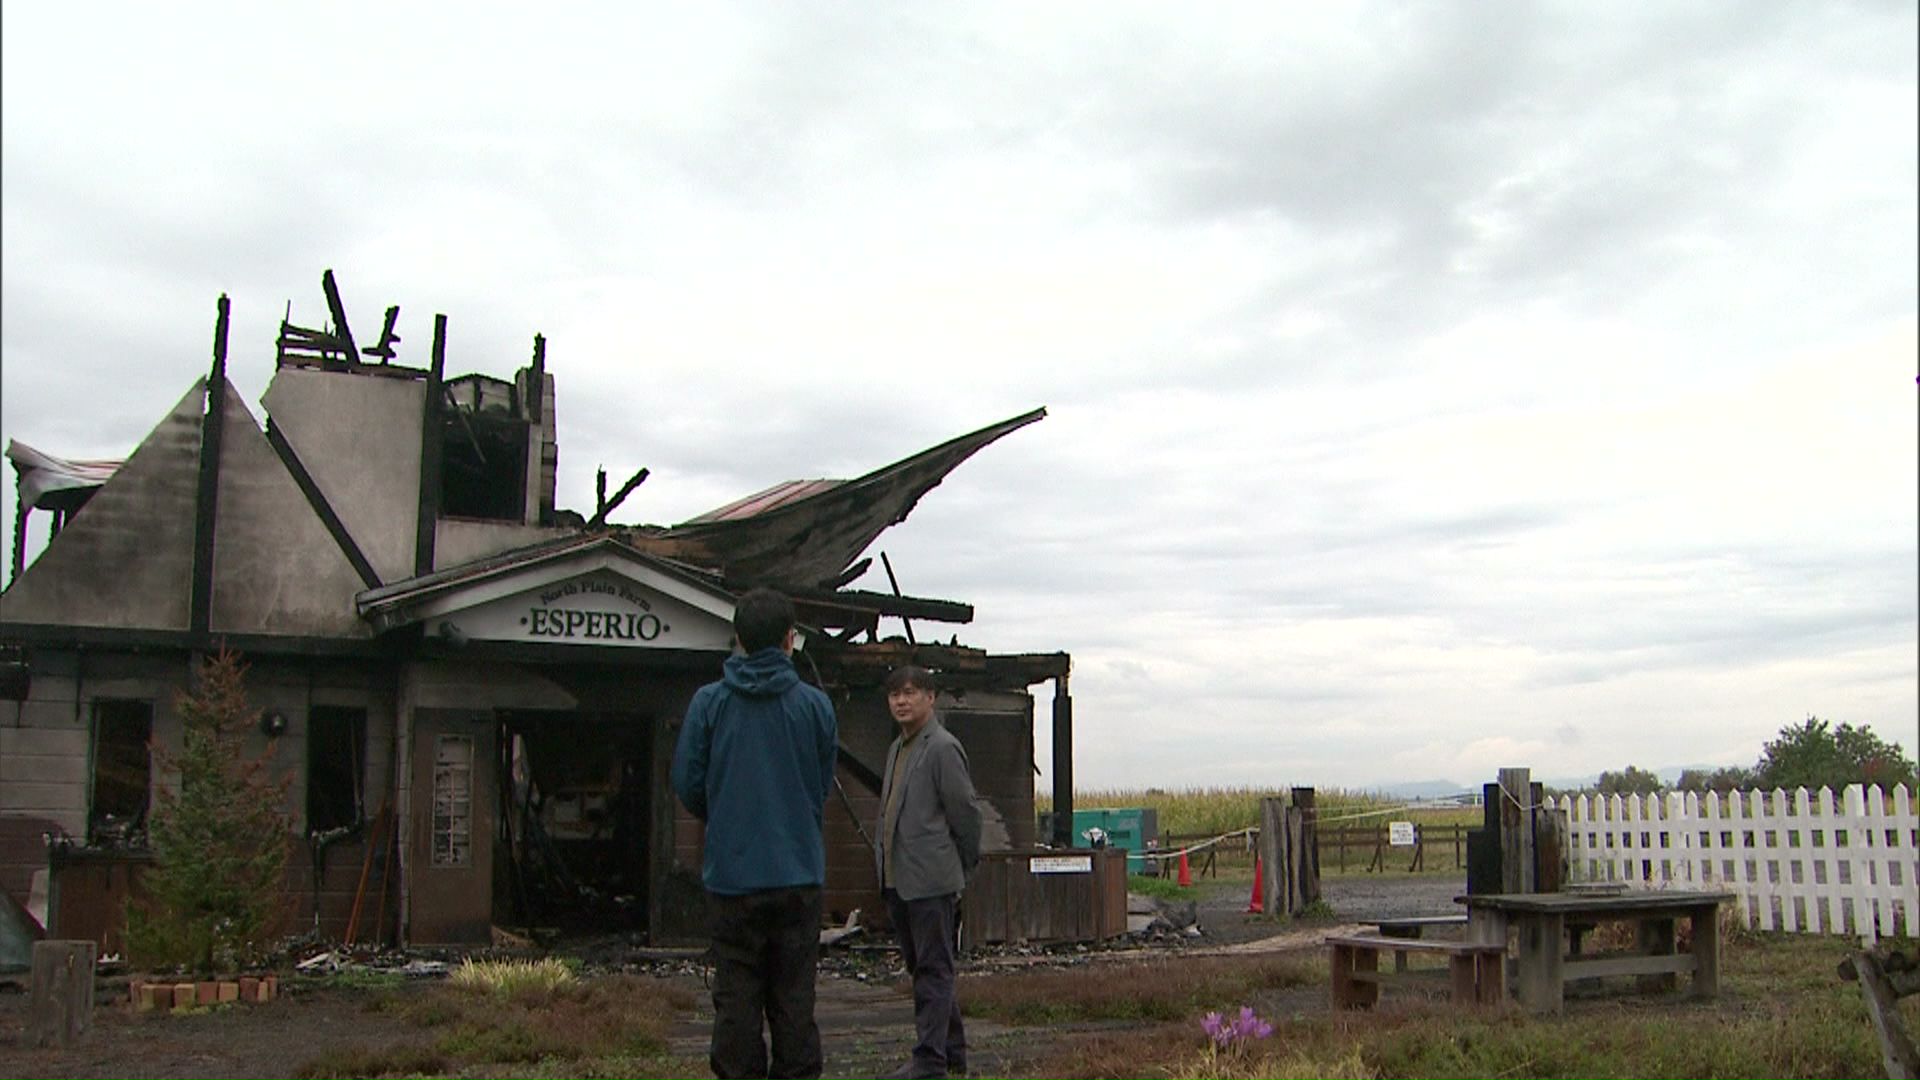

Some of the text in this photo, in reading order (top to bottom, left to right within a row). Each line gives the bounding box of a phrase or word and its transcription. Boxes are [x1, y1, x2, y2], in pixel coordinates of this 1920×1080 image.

[540, 581, 651, 612] North Plain Farm
[529, 608, 661, 641] ESPERIO
